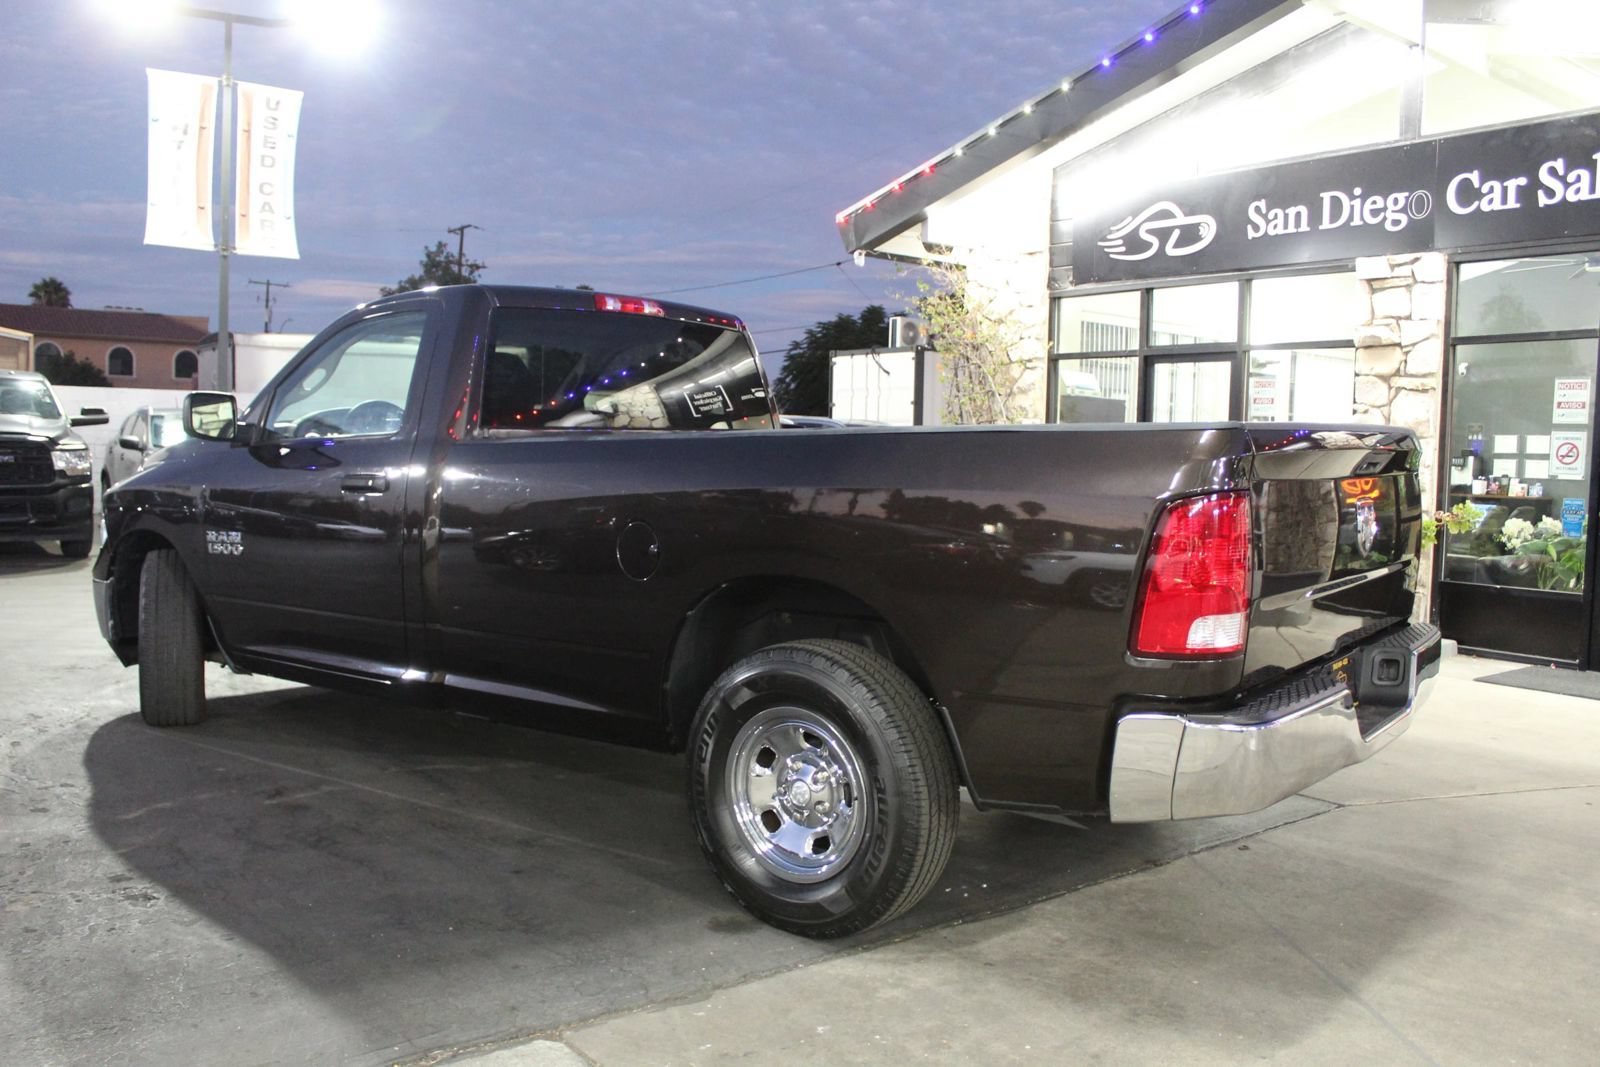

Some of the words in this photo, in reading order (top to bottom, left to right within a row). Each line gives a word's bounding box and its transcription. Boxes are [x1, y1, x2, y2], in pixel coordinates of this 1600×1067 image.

[260, 97, 280, 168] USED
[1247, 198, 1311, 240] San
[1319, 187, 1432, 232] Diego
[1446, 169, 1528, 215] Car
[208, 543, 243, 556] 1500
